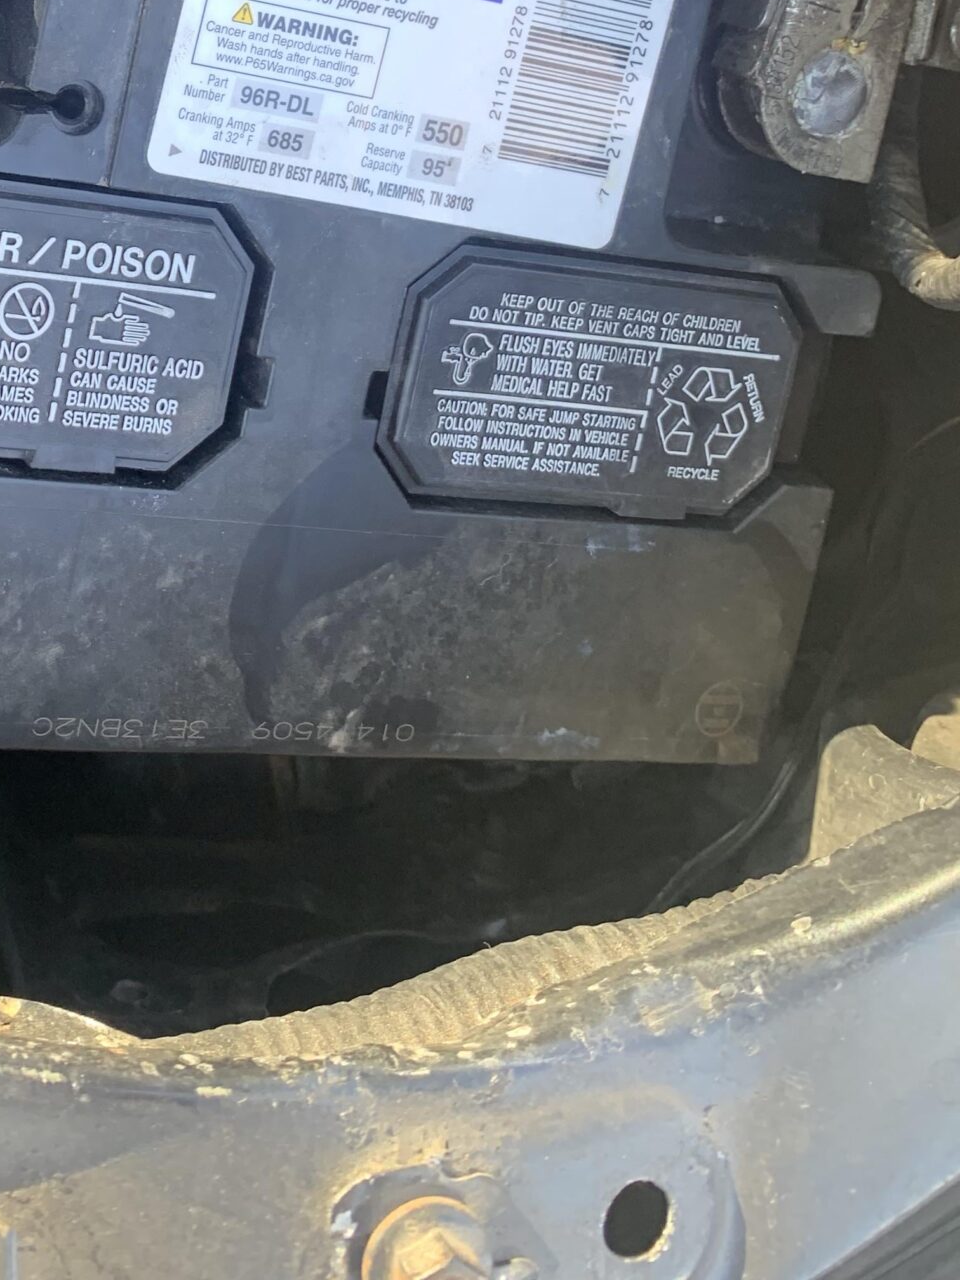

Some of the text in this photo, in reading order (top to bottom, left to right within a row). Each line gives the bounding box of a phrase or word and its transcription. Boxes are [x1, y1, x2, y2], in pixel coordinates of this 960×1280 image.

[257, 12, 359, 46] WARNING:
[382, 4, 439, 29] recycling
[206, 21, 376, 64] Cancer and Reproductive Harm.
[217, 37, 359, 76] Wash hands after handling.
[489, 66, 512, 120] 21112
[504, 6, 528, 59] 91278
[208, 74, 228, 88] Part
[216, 53, 355, 88] www.P65Warnings.ca.gov
[184, 84, 225, 102] Number
[240, 86, 314, 116] 96R-DL
[179, 108, 256, 133] Cranking Amps
[347, 101, 415, 126] Cold Cranking
[599, 188, 609, 196] 7
[606, 95, 633, 158] 21112
[626, 20, 653, 83] 91278
[213, 130, 253, 146] at 32° F
[348, 116, 376, 131] Amps
[379, 123, 389, 133] at
[405, 126, 412, 137] F
[422, 120, 463, 146] 550
[268, 130, 304, 152] 685
[366, 142, 405, 160] Reserve
[361, 156, 403, 176] Capacity
[199, 149, 474, 211] DISTRIBUTED BY BEST PARTS, INC., MEMPHIS, TN 38103
[28, 237, 56, 265] /
[62, 240, 196, 283] POISON
[501, 293, 741, 333] KEEP OUT OF THE REACH OF CHILDREN
[469, 306, 760, 351] DO NOT TIP. KEEP VENT CAPS TIGHT AND LEVEL
[0, 340, 30, 362] NO
[73, 348, 204, 379] SULFURIC ACID
[499, 334, 656, 366] FLUSH EYES IMMEDIATELY
[497, 354, 603, 381] WITH WATER. GET
[657, 364, 684, 395] LEAD
[70, 372, 156, 393] CAN CAUSE
[491, 375, 613, 402] MEDICAL HELP FAST
[66, 391, 178, 415] BLINDNESS OR
[743, 373, 765, 423] RETURN
[62, 411, 173, 434] SEVERE BURNS
[438, 399, 636, 430] CAUTION: FOR SAFE JUMP STARTING
[438, 416, 628, 446] FOLLOW INSTRUCTIONS IN VEHICLE
[430, 432, 630, 462] OWNERS MANUAL. IF NOT AVAILABLE
[452, 451, 600, 477] SEEK SERVICE ASSISTANCE.
[667, 466, 720, 481] RECYCLE
